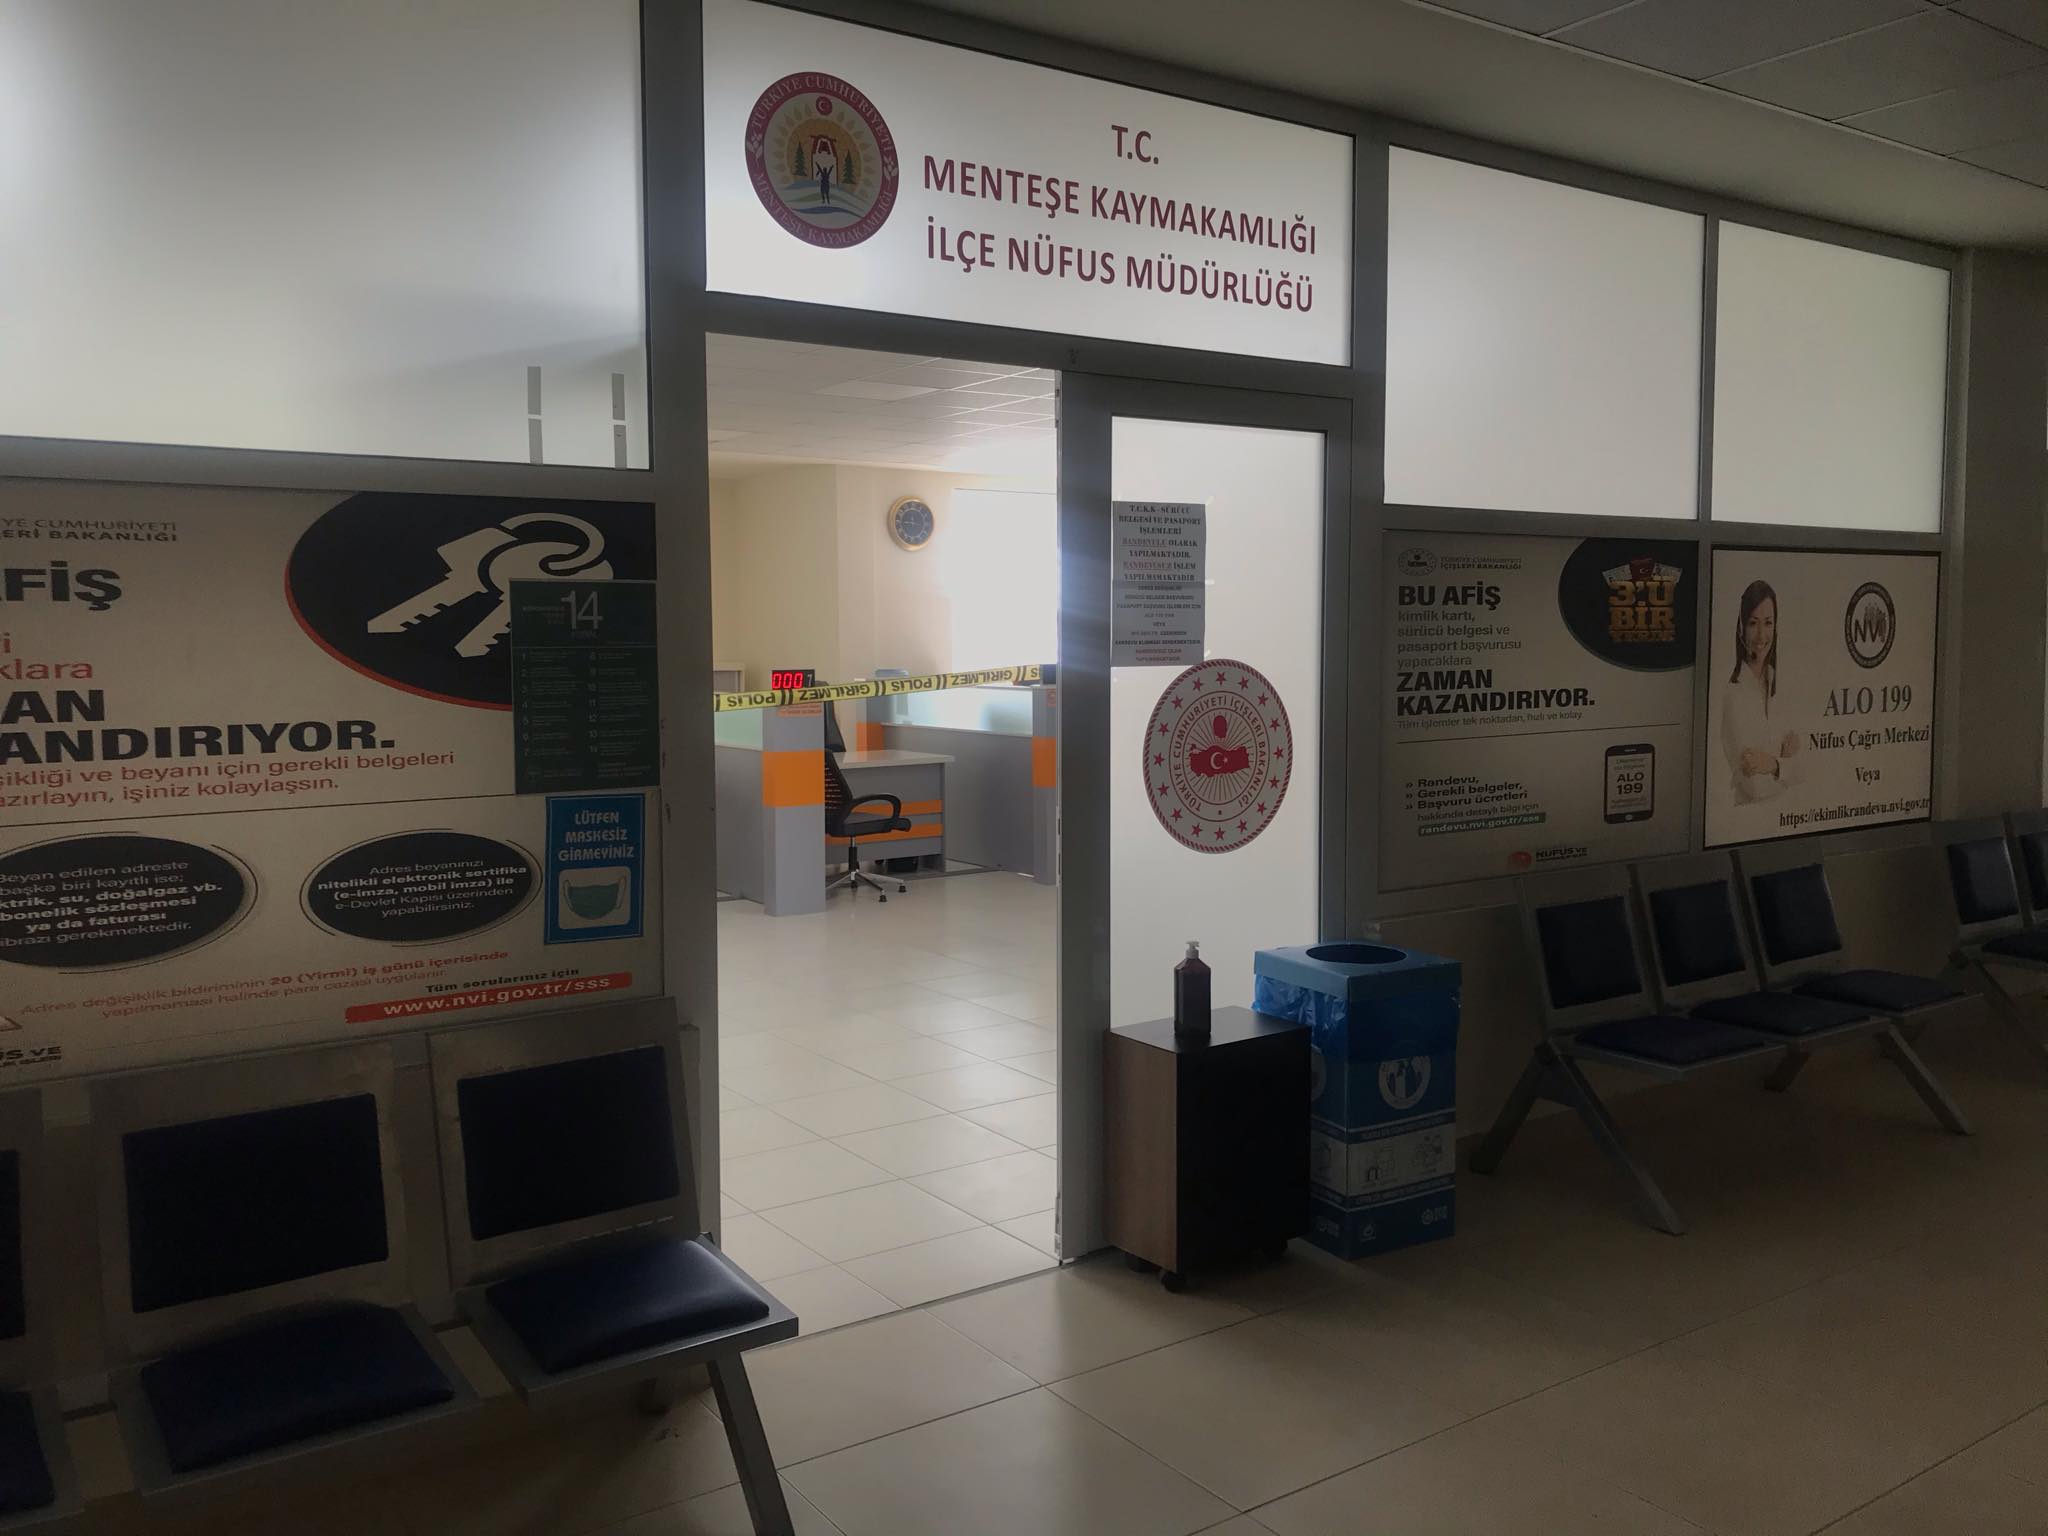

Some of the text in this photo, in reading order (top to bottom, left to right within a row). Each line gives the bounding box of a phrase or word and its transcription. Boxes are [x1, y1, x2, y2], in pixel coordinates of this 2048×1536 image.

[1112, 125, 1160, 165] T.C.
[924, 155, 1316, 255] MENTEŞE KAYMAKAMLIĞI
[927, 215, 1313, 313] İLÇE NÜFUS MÜDÜRLÜĞÜ
[0, 528, 178, 543] ERİ BAKANLIĞI
[0, 560, 122, 611] FİŞ
[1398, 580, 1502, 610] BU AFİŞ
[561, 590, 604, 632] 14
[1398, 609, 1476, 624] kimlik kartı,
[1397, 623, 1510, 639] sürücü belgesi ve
[1397, 638, 1521, 654] pasaport başvurusu
[1397, 655, 1472, 671] yapacaklara
[772, 671, 804, 689] 000
[1396, 669, 1492, 692] ZAMAN
[1396, 687, 1596, 717] KAZANDIRIYOR.
[1823, 684, 1912, 718] ALO 199
[1808, 723, 1930, 752] Nüfus Çağrı Merkezi
[80, 769, 113, 784] ve
[121, 763, 209, 785] beyanı
[217, 760, 261, 779] için
[268, 755, 349, 777] gerekli
[356, 751, 456, 771] belgeleri
[1855, 766, 1881, 786] Veya
[1418, 776, 1480, 788] Randevu,
[1617, 772, 1645, 783] ALO
[122, 782, 188, 803] işiniz
[197, 777, 339, 799] kolaylaşsın.
[1417, 781, 1523, 799] Gerekli belgeler,
[1617, 783, 1643, 795] 199
[1417, 789, 1528, 810] Başvuru ücretleri
[575, 810, 619, 825] LÜTFEN
[565, 827, 629, 844] MASKESİZ
[558, 844, 635, 862] GİRMEYİNİZ
[59, 864, 116, 878] edilen
[121, 861, 189, 874] adreste
[318, 865, 528, 890] nitelikli elektronik sertifika
[369, 863, 412, 875] Adres
[59, 894, 90, 904] su,
[95, 886, 188, 901] doğalgaz
[193, 882, 223, 892] vb.
[62, 880, 90, 891] biri
[403, 881, 447, 894] mobil
[450, 877, 493, 892] imza)
[496, 876, 514, 886] ile
[83, 897, 198, 915] sözleşmesi
[335, 897, 396, 910] e-Devlet
[26, 913, 167, 934] ya da faturası
[270, 974, 294, 987] 20
[425, 983, 458, 994] Tüm
[551, 967, 579, 981] için
[383, 976, 611, 1016] www.nvi.gov.tr/sss
